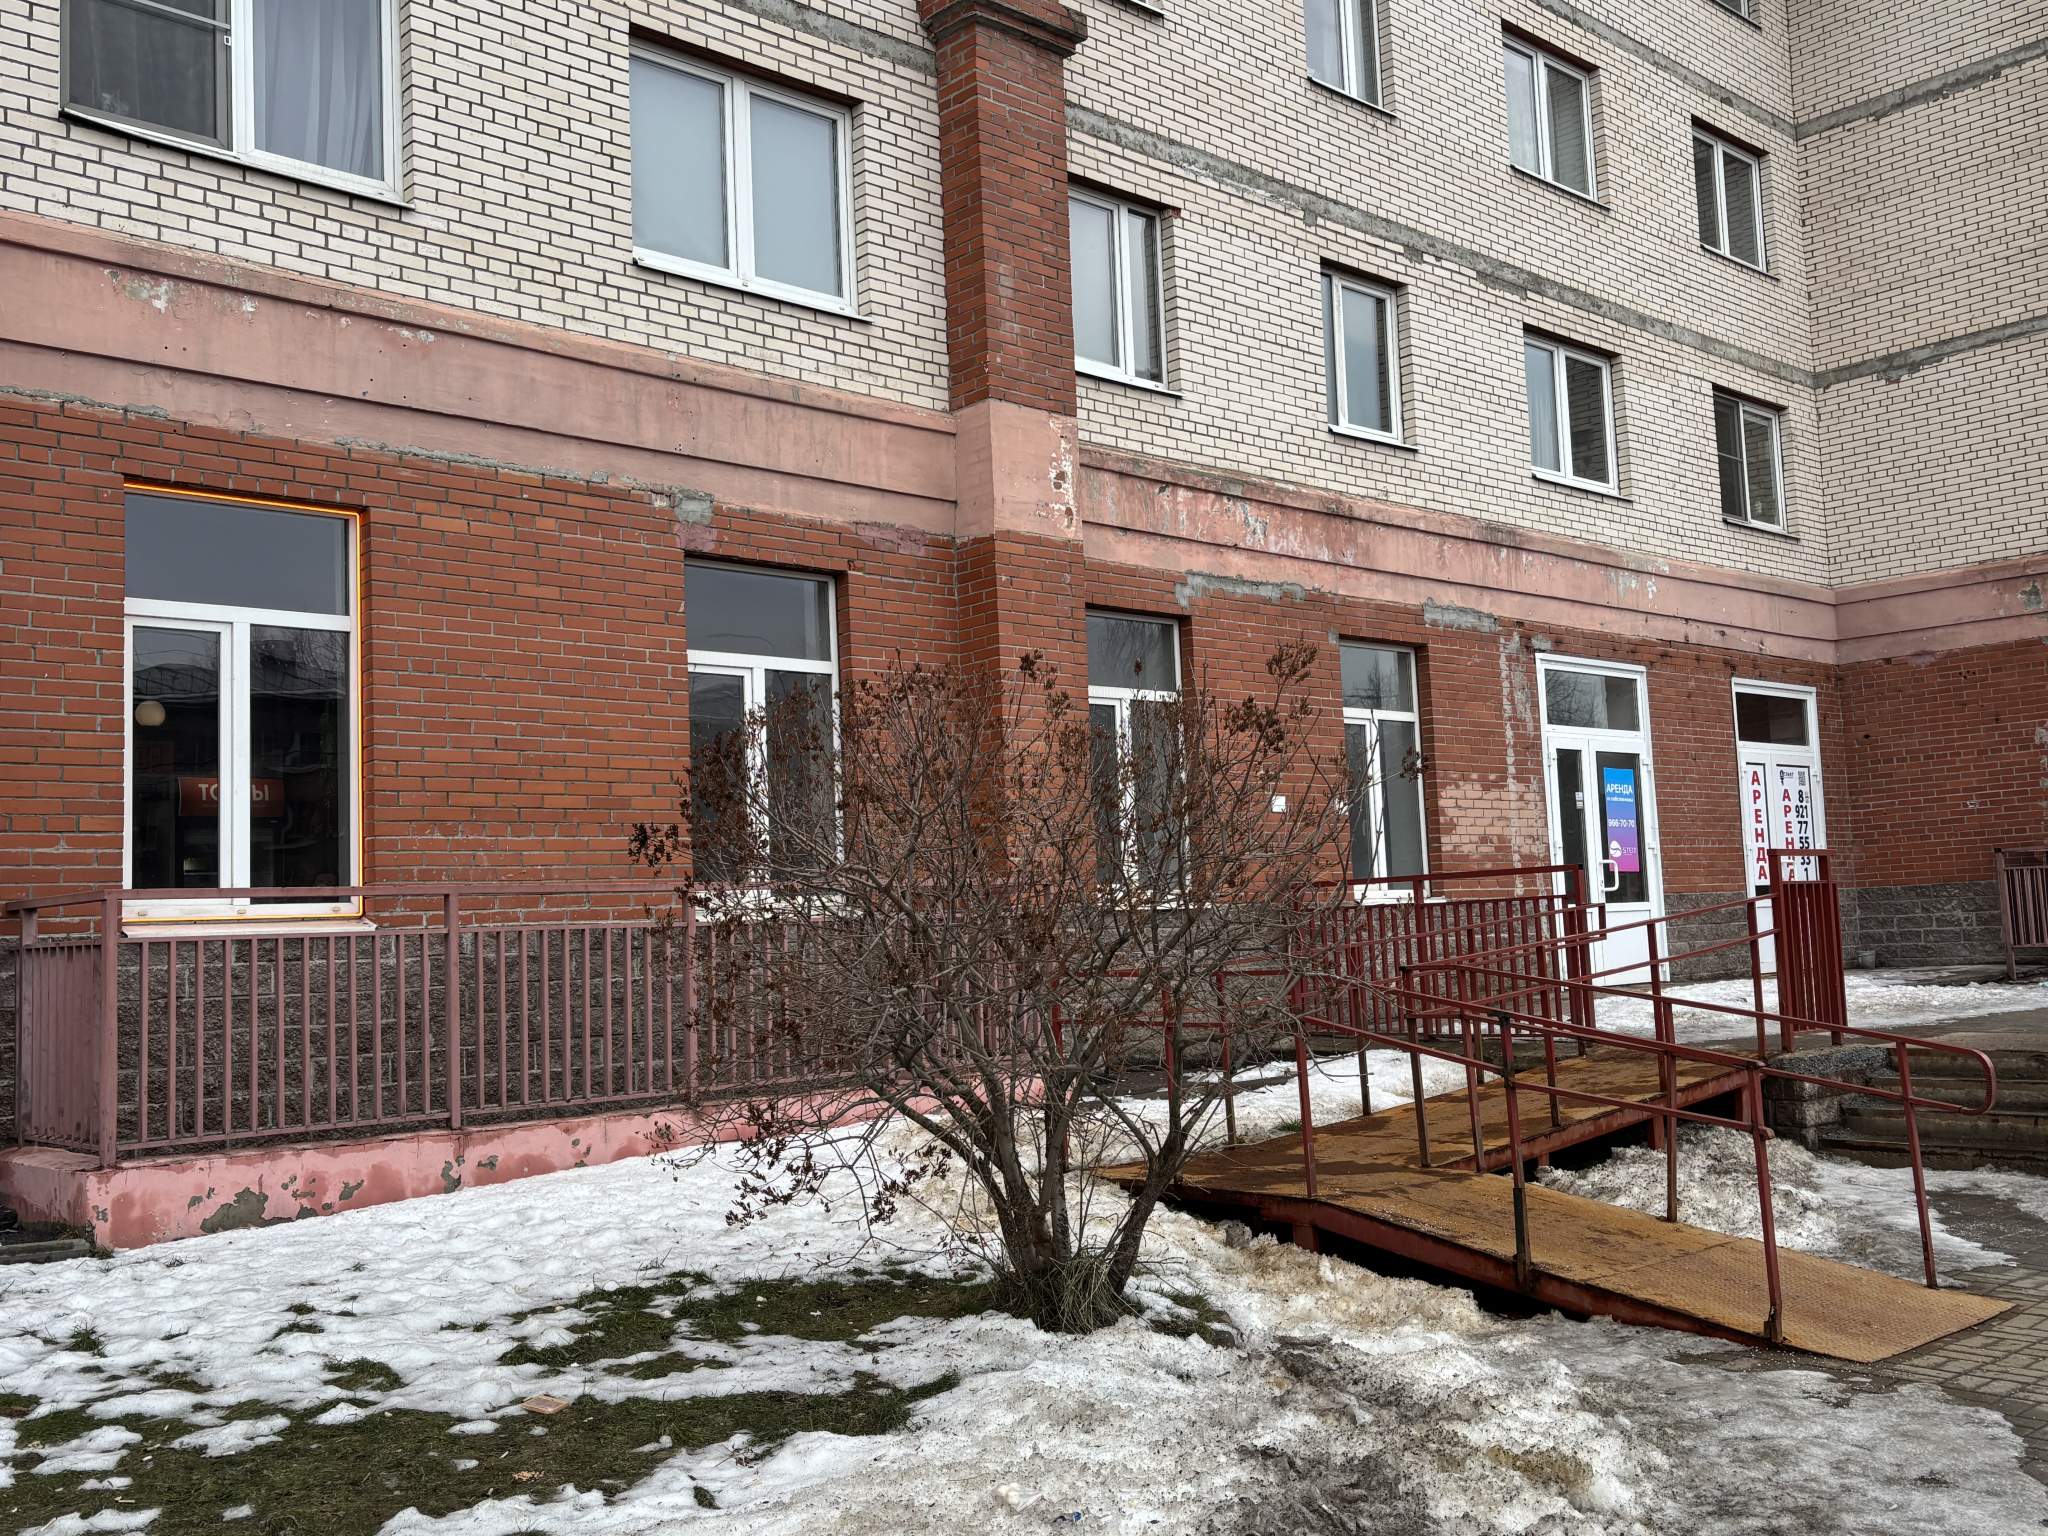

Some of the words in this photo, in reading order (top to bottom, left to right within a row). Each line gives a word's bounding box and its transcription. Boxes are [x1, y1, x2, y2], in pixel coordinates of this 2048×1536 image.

[198, 783, 270, 801] ТОЫ
[1606, 783, 1633, 795] АРЕНДА
[1798, 789, 1804, 803] 8
[1795, 804, 1808, 818] 921
[1751, 770, 1768, 880] АРЕНДА
[1797, 820, 1808, 834] 77
[1799, 836, 1810, 850] 55
